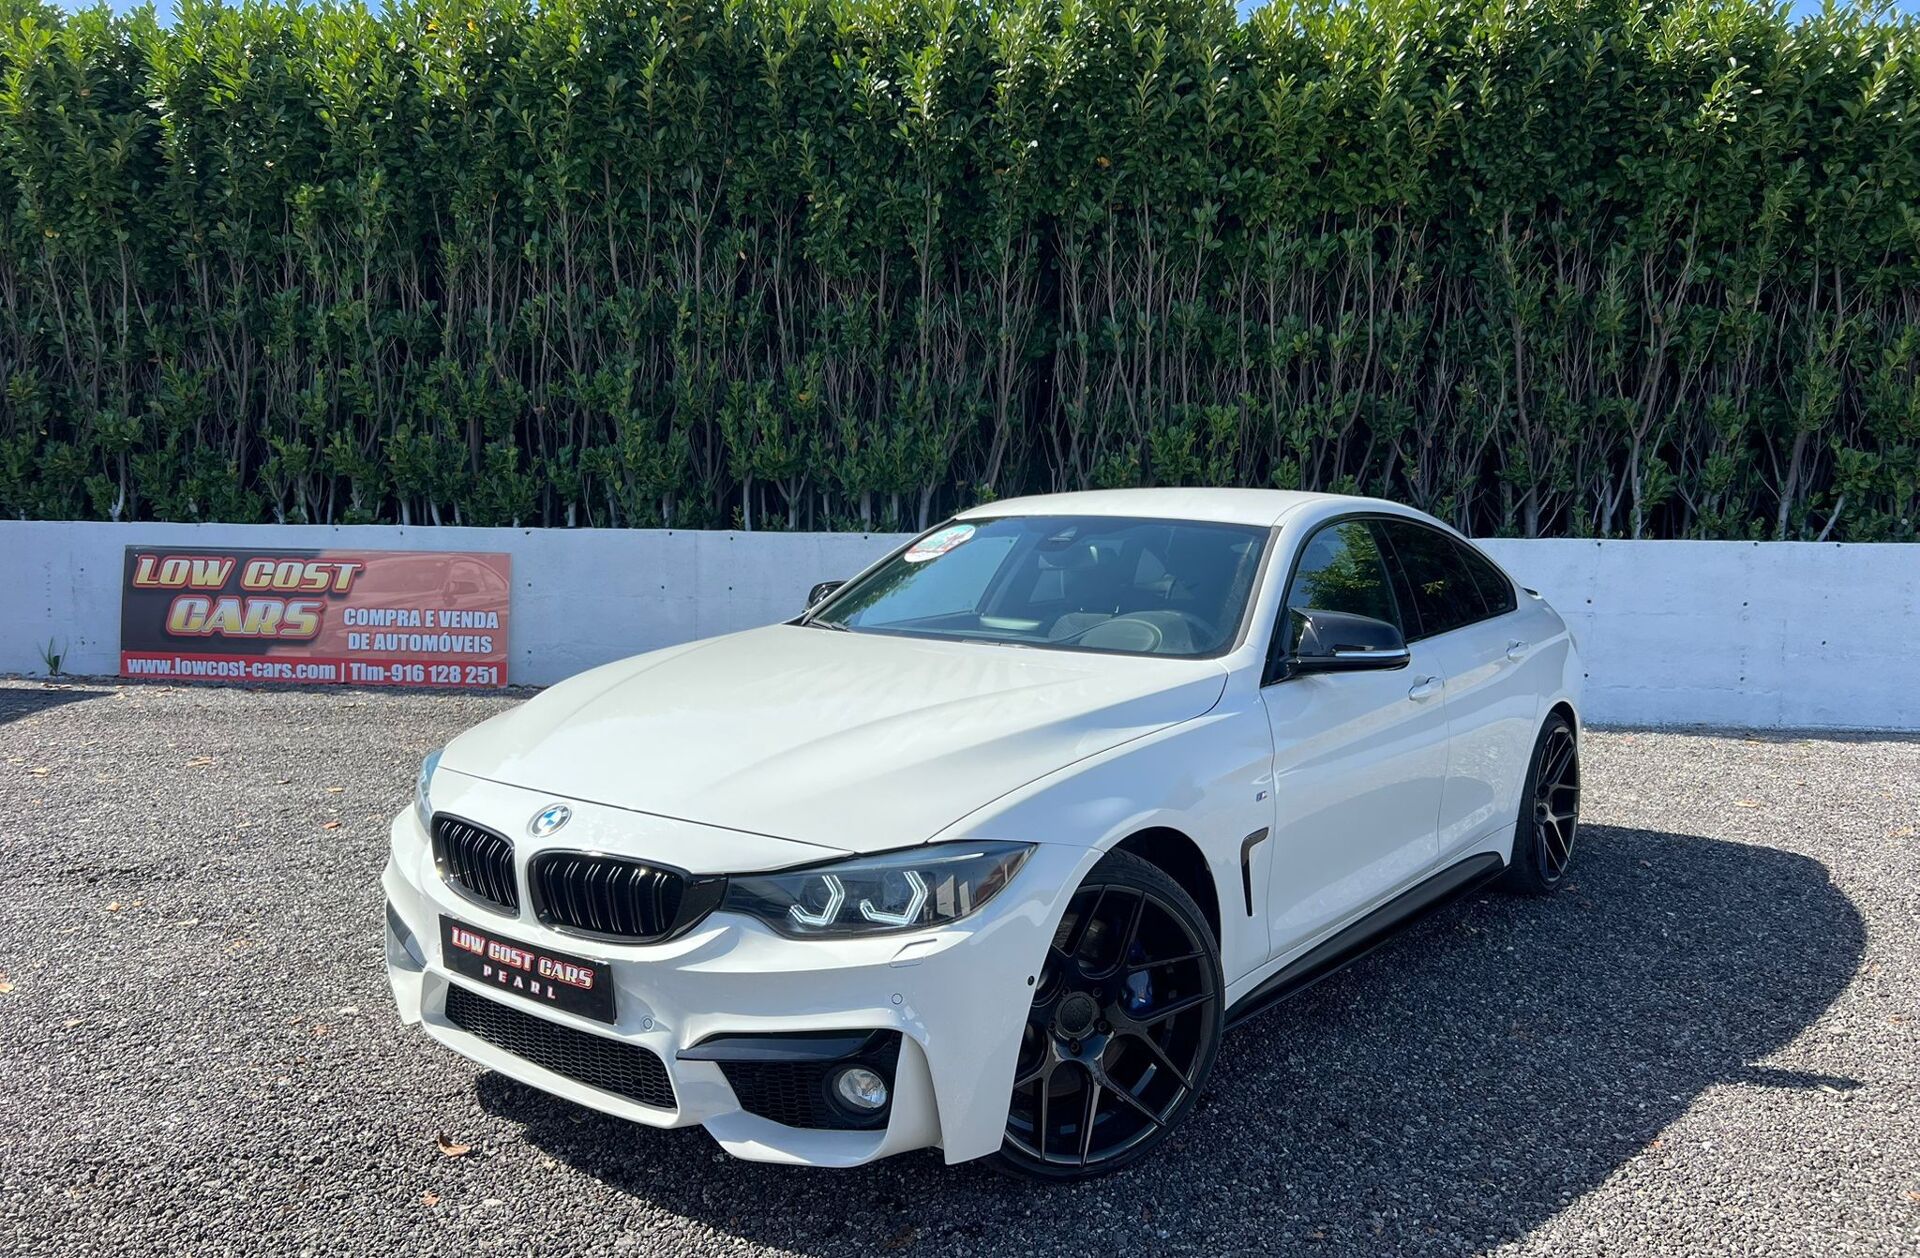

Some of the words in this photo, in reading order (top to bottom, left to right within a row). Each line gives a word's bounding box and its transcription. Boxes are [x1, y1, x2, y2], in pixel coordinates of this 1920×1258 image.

[134, 556, 235, 589] LOW
[243, 559, 365, 592] COST
[168, 596, 324, 638] CARS
[344, 608, 421, 628] COMPRA
[425, 609, 434, 628] E
[439, 610, 499, 629] VENDA
[348, 632, 370, 650] DE
[373, 631, 493, 653] AUTOMÓVEIS
[127, 657, 336, 680] www.lowcost-cars.com
[428, 665, 461, 684] 128
[465, 666, 498, 684] 251
[451, 927, 486, 956] LOW
[488, 940, 535, 972] COST
[538, 957, 594, 990] CARS
[483, 964, 556, 1000] PEARL
